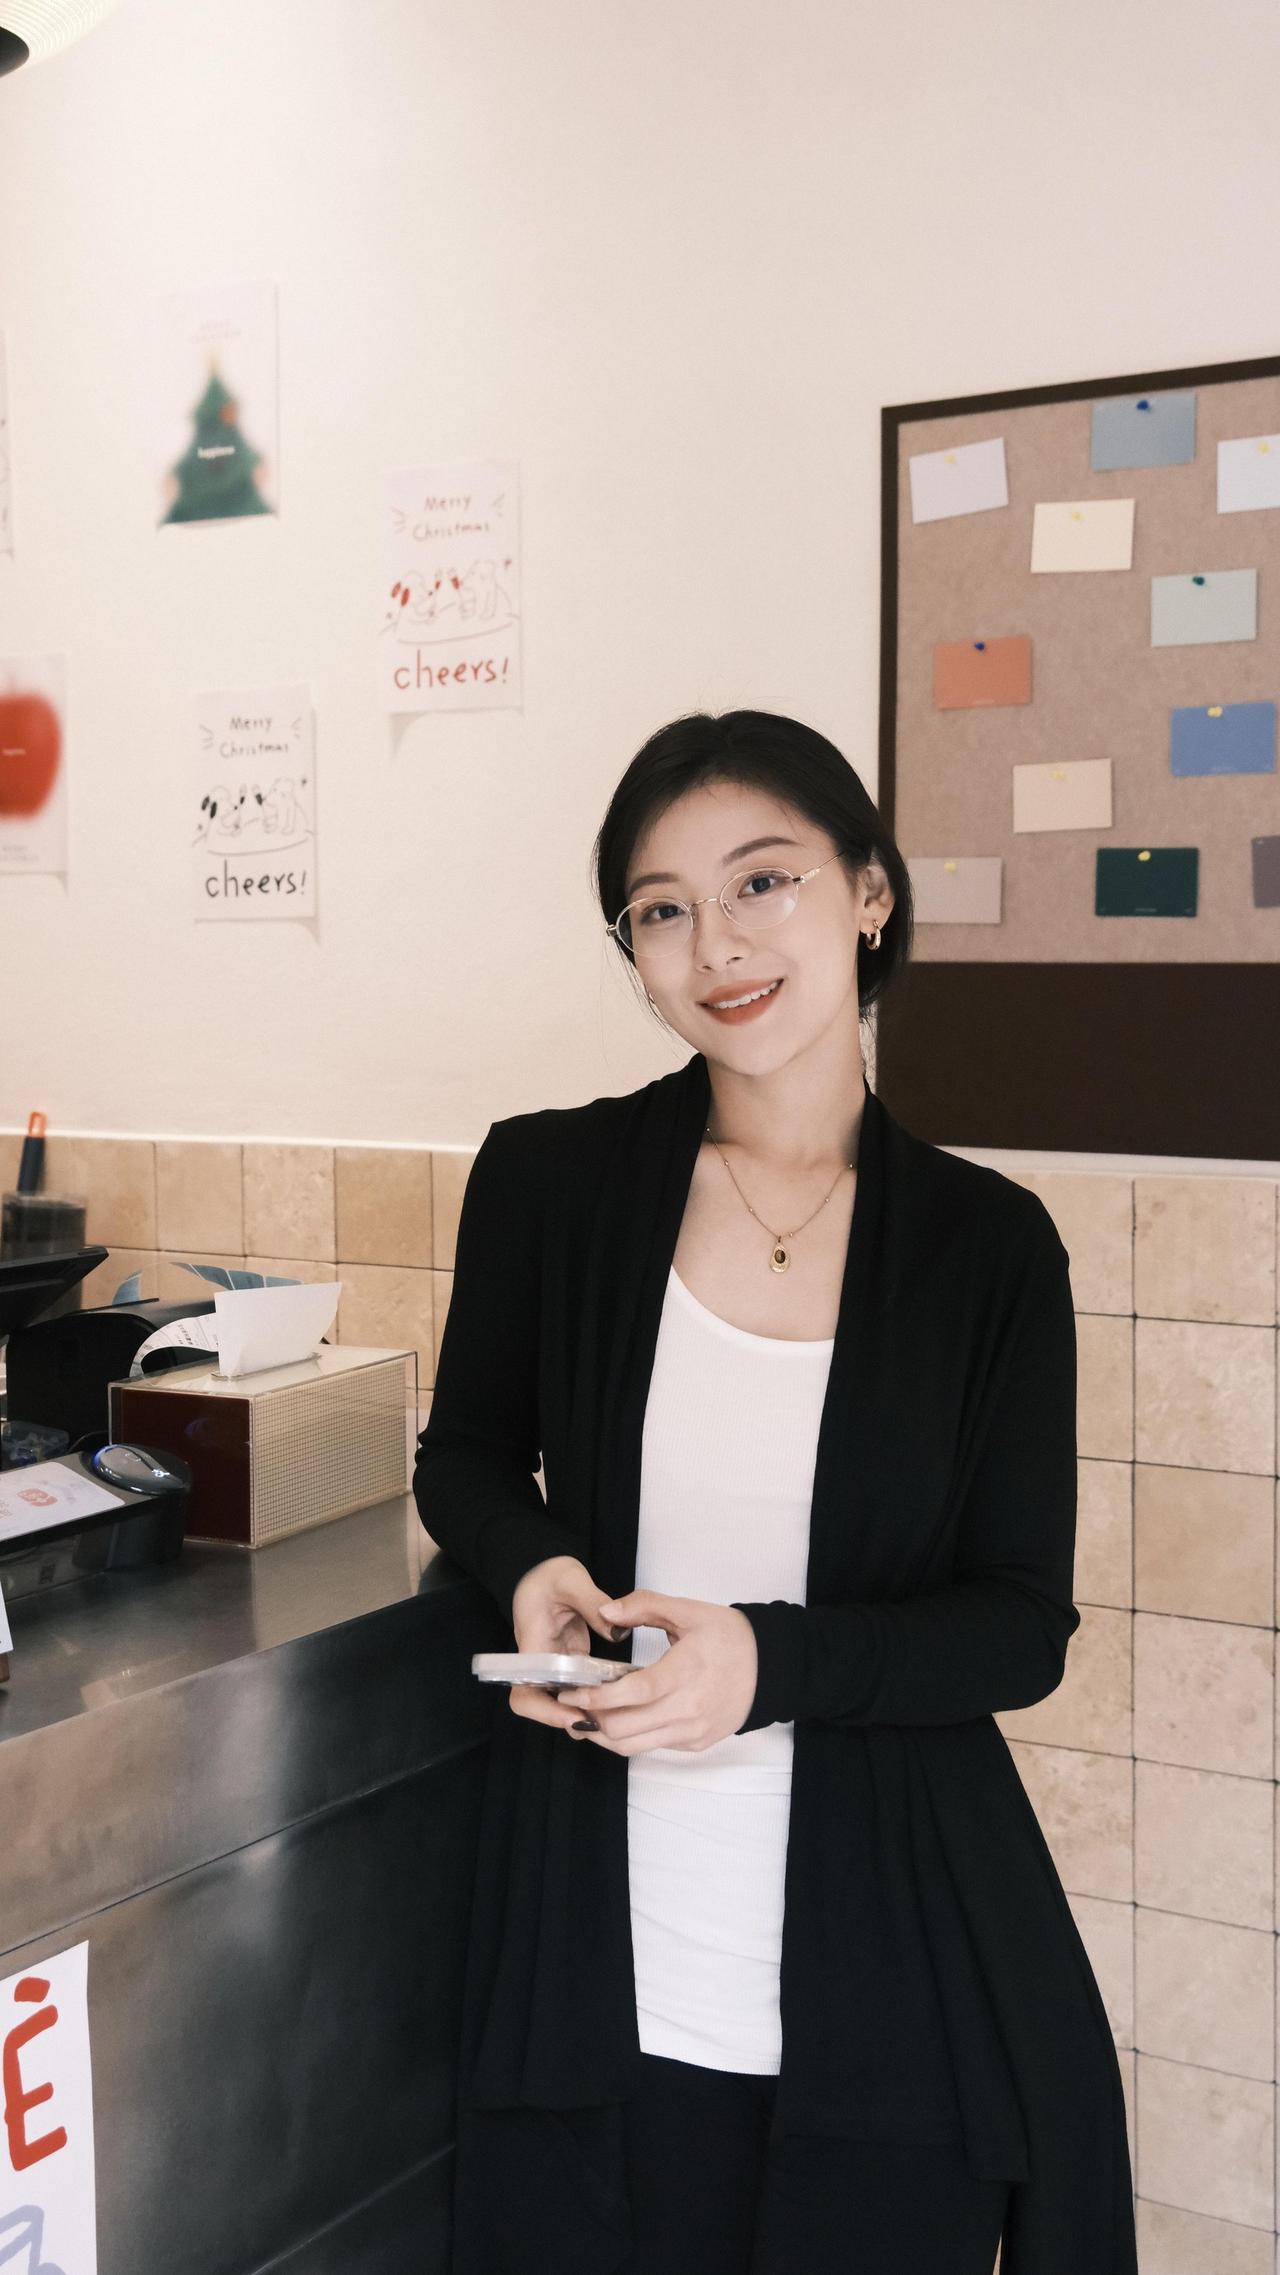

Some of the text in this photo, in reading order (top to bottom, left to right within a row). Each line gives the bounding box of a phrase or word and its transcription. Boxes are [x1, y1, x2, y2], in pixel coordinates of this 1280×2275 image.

[424, 496, 471, 511] Merry
[413, 522, 490, 541] Christmas
[394, 649, 508, 689] cheers!
[229, 716, 273, 732] Merry
[219, 743, 289, 759] Christmas
[205, 859, 307, 898] cheers!
